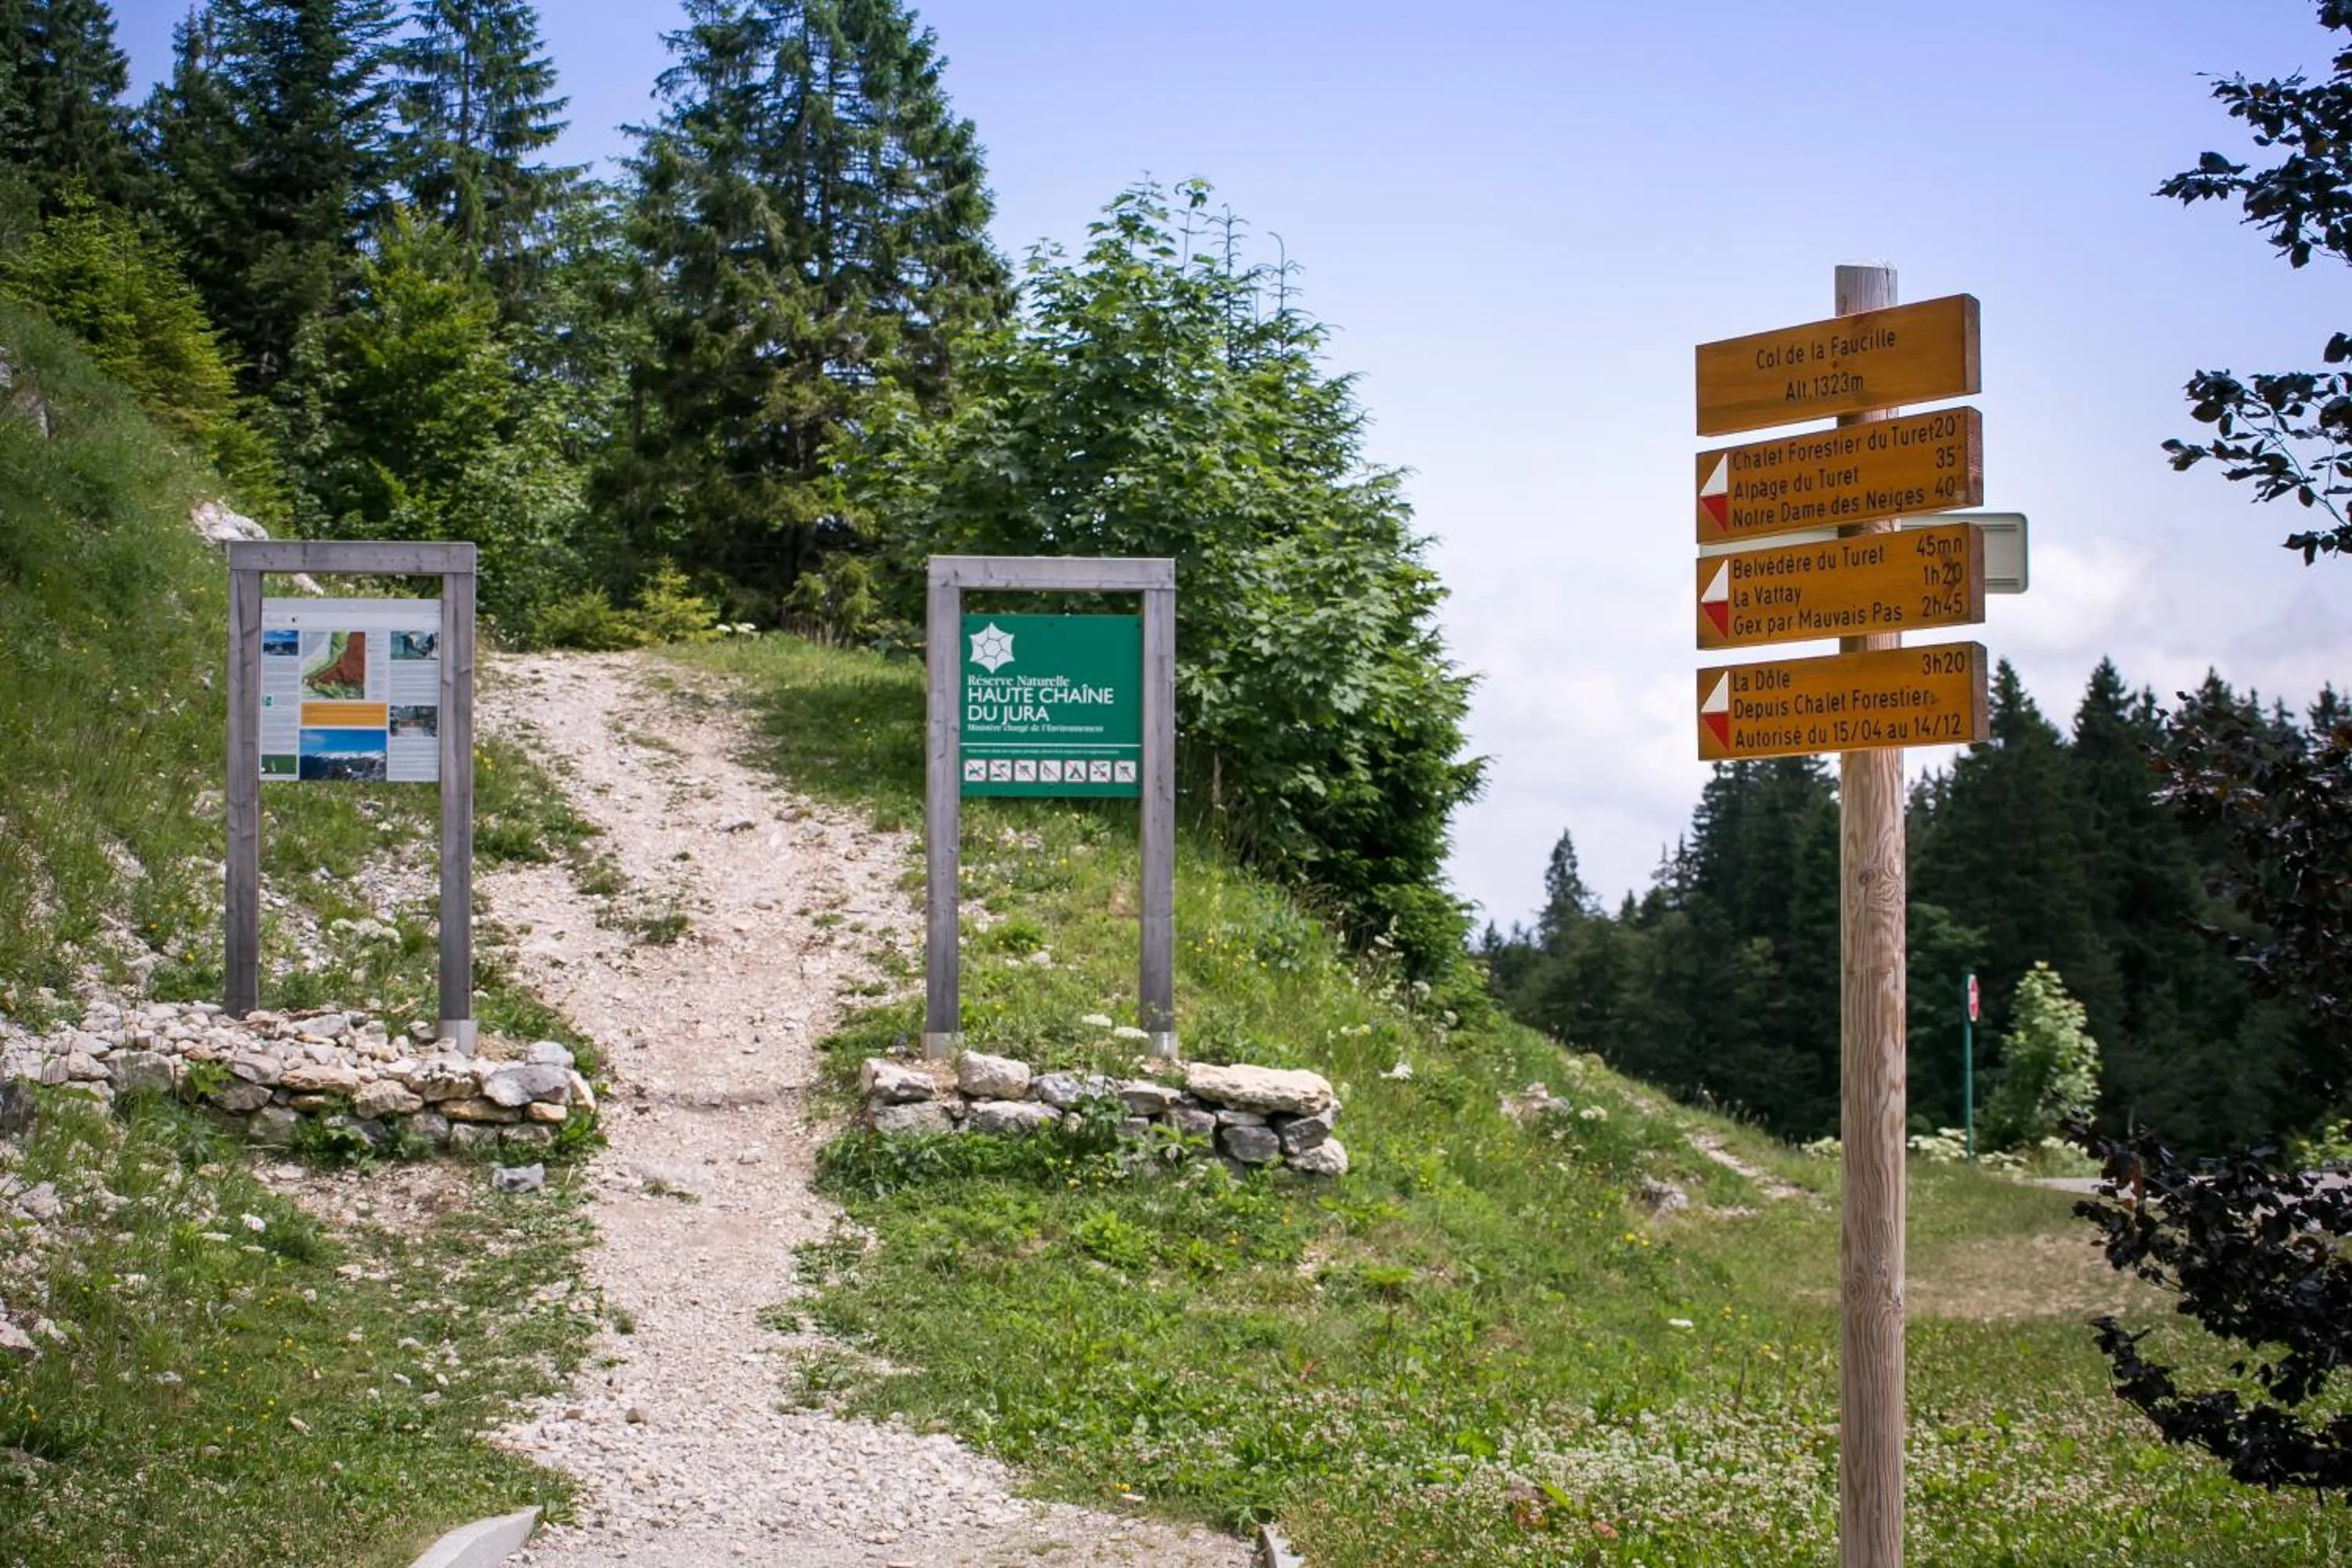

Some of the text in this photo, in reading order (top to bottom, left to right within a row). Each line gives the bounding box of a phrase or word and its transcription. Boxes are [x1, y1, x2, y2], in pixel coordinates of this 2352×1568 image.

[1755, 328, 1896, 369] Col de la Faucille
[1732, 445, 1783, 470] Chalet
[1788, 434, 1861, 462] Forestier
[1867, 426, 1887, 451] du
[1891, 423, 1933, 447] Turet
[1733, 479, 1788, 504] Alpage
[1793, 473, 1813, 493] du
[1818, 465, 1859, 489] Turet
[1733, 506, 1774, 528] Notre
[1780, 501, 1825, 522] Dame
[1831, 495, 1860, 515] des
[1866, 486, 1925, 513] Neiges
[1733, 535, 1962, 579] Belvédère du Turet 45mn
[1733, 561, 1962, 608] La Vattay 1h20
[1733, 592, 1962, 637] Gex par Mauvais Pas 2h45
[967, 674, 1070, 688] Réserve Naturelle
[1733, 651, 1965, 691] La Dôle 3h20
[967, 684, 1114, 705] HAUTE CHAÎNE
[1733, 685, 1929, 723] Depuis Chalet Forestier
[967, 706, 1051, 725] DU JURA
[1735, 713, 1962, 749] Autorisé du 15/04 au 14/12
